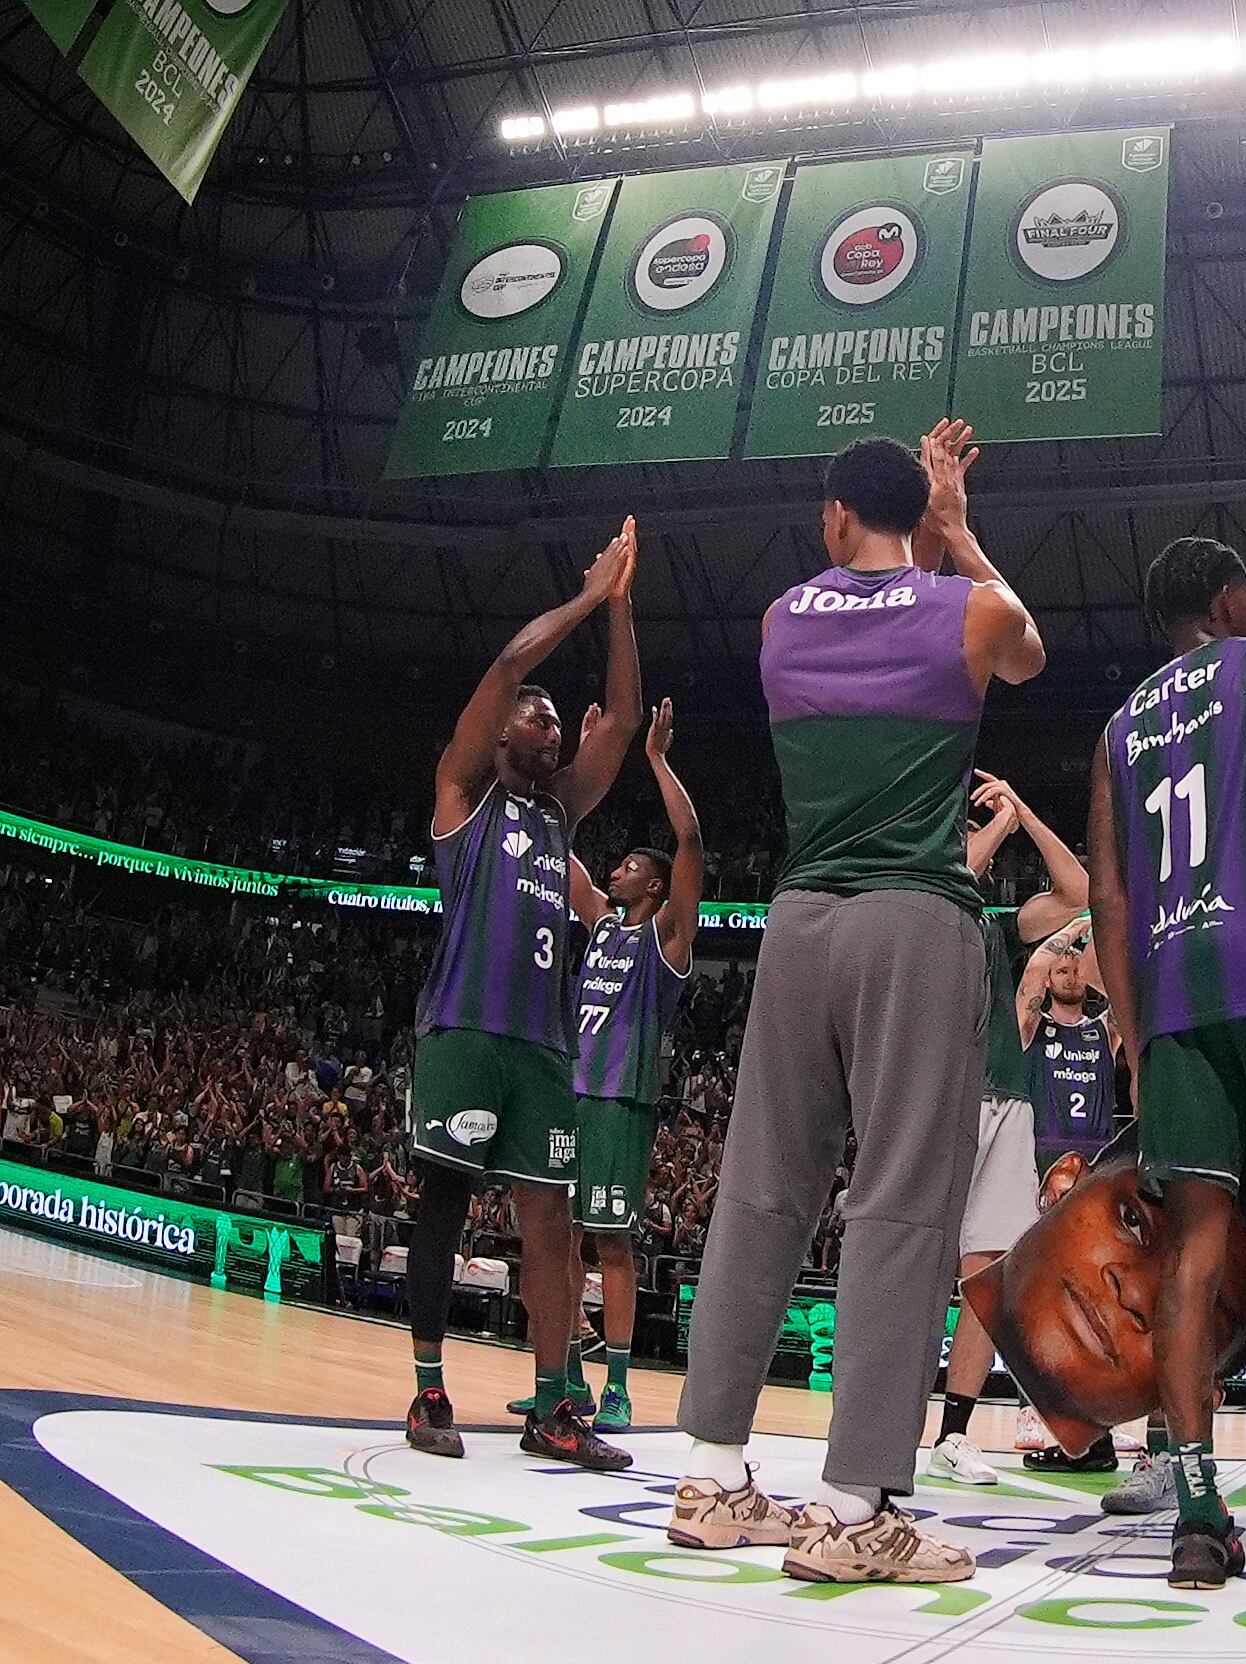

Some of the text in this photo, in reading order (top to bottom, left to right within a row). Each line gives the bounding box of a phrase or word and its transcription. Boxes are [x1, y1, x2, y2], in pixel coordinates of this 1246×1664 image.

[136, 0, 241, 110] AMPEONES
[152, 50, 183, 98] BCL
[135, 69, 175, 127] 2024
[1026, 224, 1108, 239] FINAL FOUR
[969, 302, 1155, 347] CAMPEONES
[578, 331, 740, 376] CAMPEONES
[768, 325, 946, 372] CAMPEONES
[1041, 340, 1105, 352] CHAMPIONS
[1110, 339, 1153, 350] LEAGUE
[413, 344, 559, 391] CAMPEONES
[766, 361, 942, 390] COPA DEL REY
[1031, 351, 1084, 374] BCL
[574, 366, 734, 398] SUPERCOPA
[1025, 378, 1088, 403] 2025
[441, 417, 493, 441] 2024
[616, 405, 673, 429] 2024
[816, 402, 877, 427] 2025
[789, 586, 917, 614] Joma
[1129, 659, 1223, 717] Carter
[1144, 762, 1210, 883] 11
[96, 850, 154, 875] porque
[155, 861, 170, 877] la
[173, 866, 230, 889] vivimos
[230, 874, 280, 897] juntos
[327, 889, 380, 909] Cuatro
[533, 927, 555, 970] 3
[578, 1003, 611, 1036] 77
[1069, 1091, 1087, 1118] 2
[80, 1194, 196, 1256] histórica
